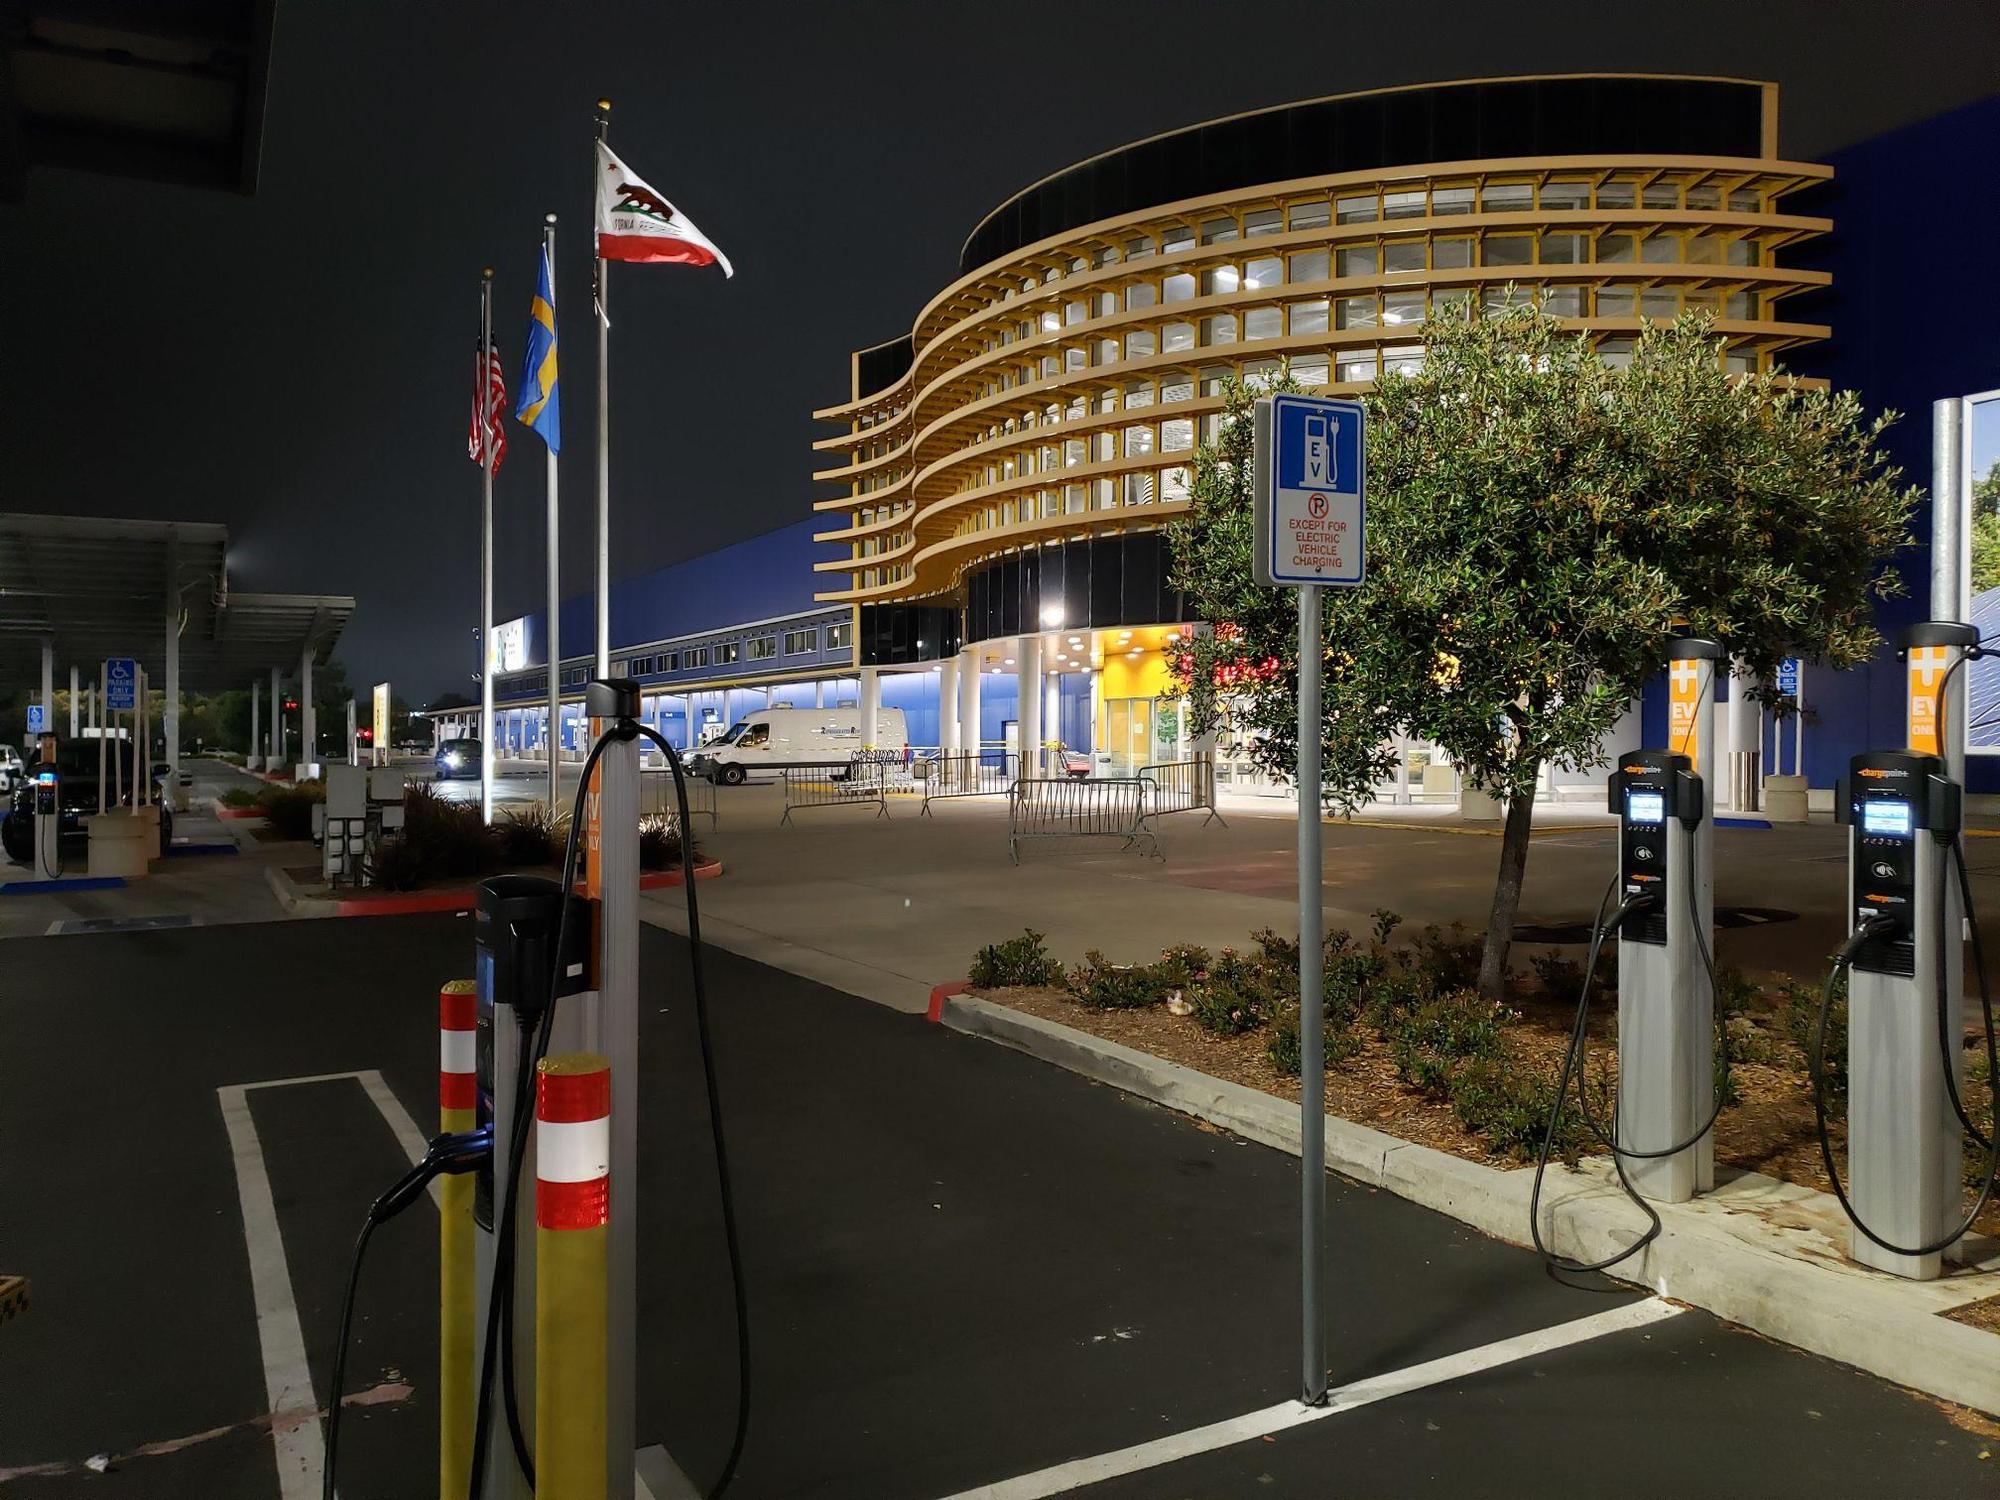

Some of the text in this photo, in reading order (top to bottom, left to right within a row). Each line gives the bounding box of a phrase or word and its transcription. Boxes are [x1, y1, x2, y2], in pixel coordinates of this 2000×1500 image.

[1289, 518, 1347, 532] EXCEPT FOR
[1296, 531, 1341, 544] ELECTRIC
[1298, 543, 1338, 556] VEHICLE
[1292, 555, 1343, 568] CHARGING
[1672, 702, 1695, 720] EV
[1911, 725, 1937, 735] ONL
